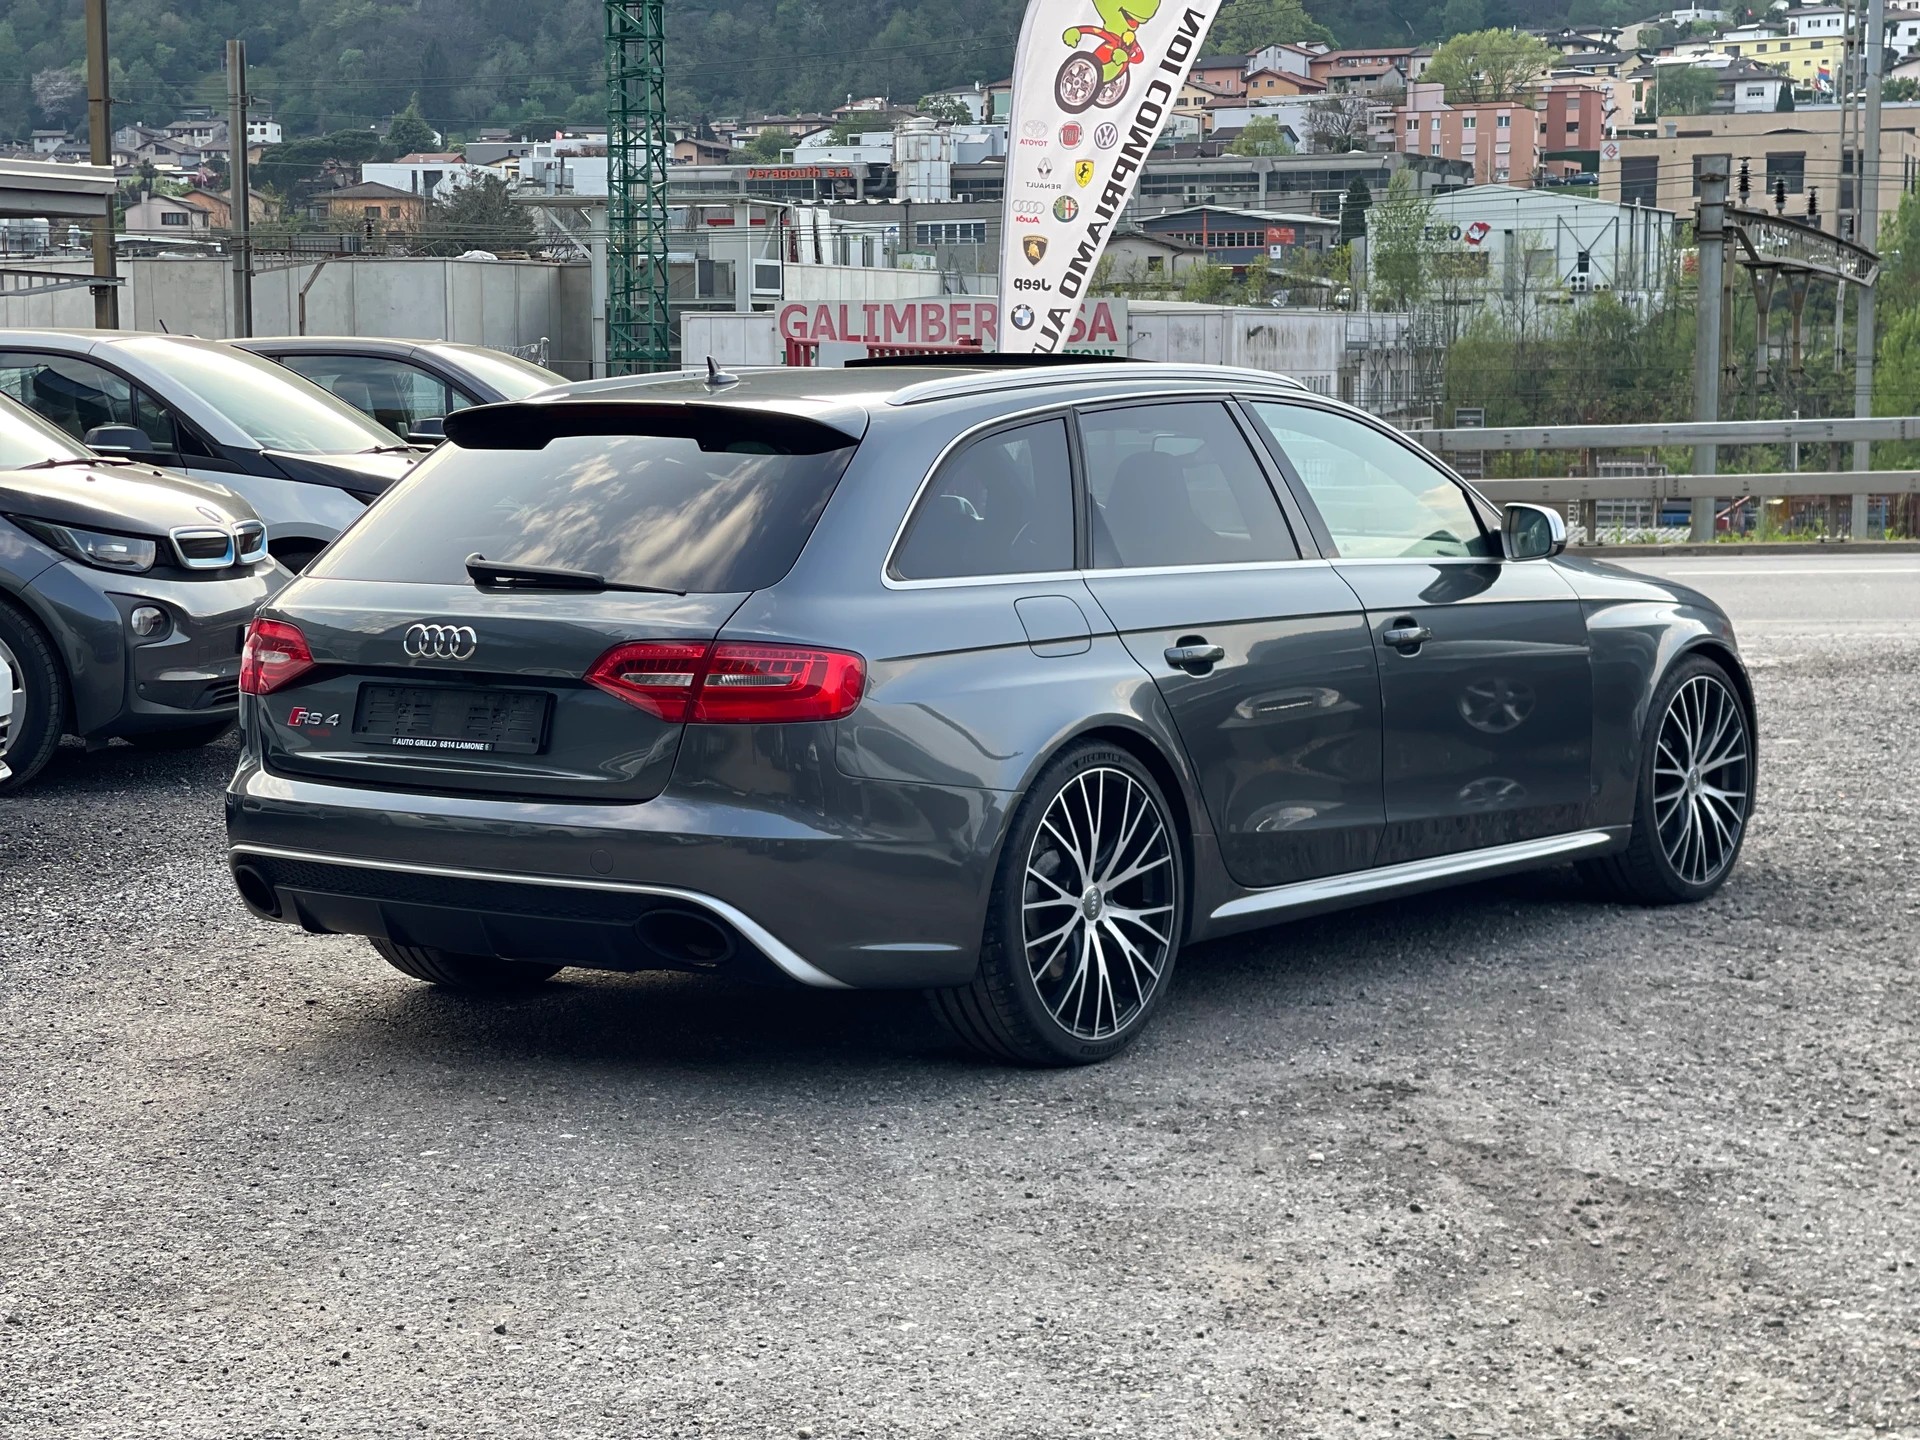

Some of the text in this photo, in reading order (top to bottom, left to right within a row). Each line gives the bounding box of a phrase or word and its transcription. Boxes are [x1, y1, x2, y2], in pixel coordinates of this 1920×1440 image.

[779, 303, 998, 343] GALIMBER
[396, 738, 485, 751] AUTO GRILLO 6814 LAMONE
